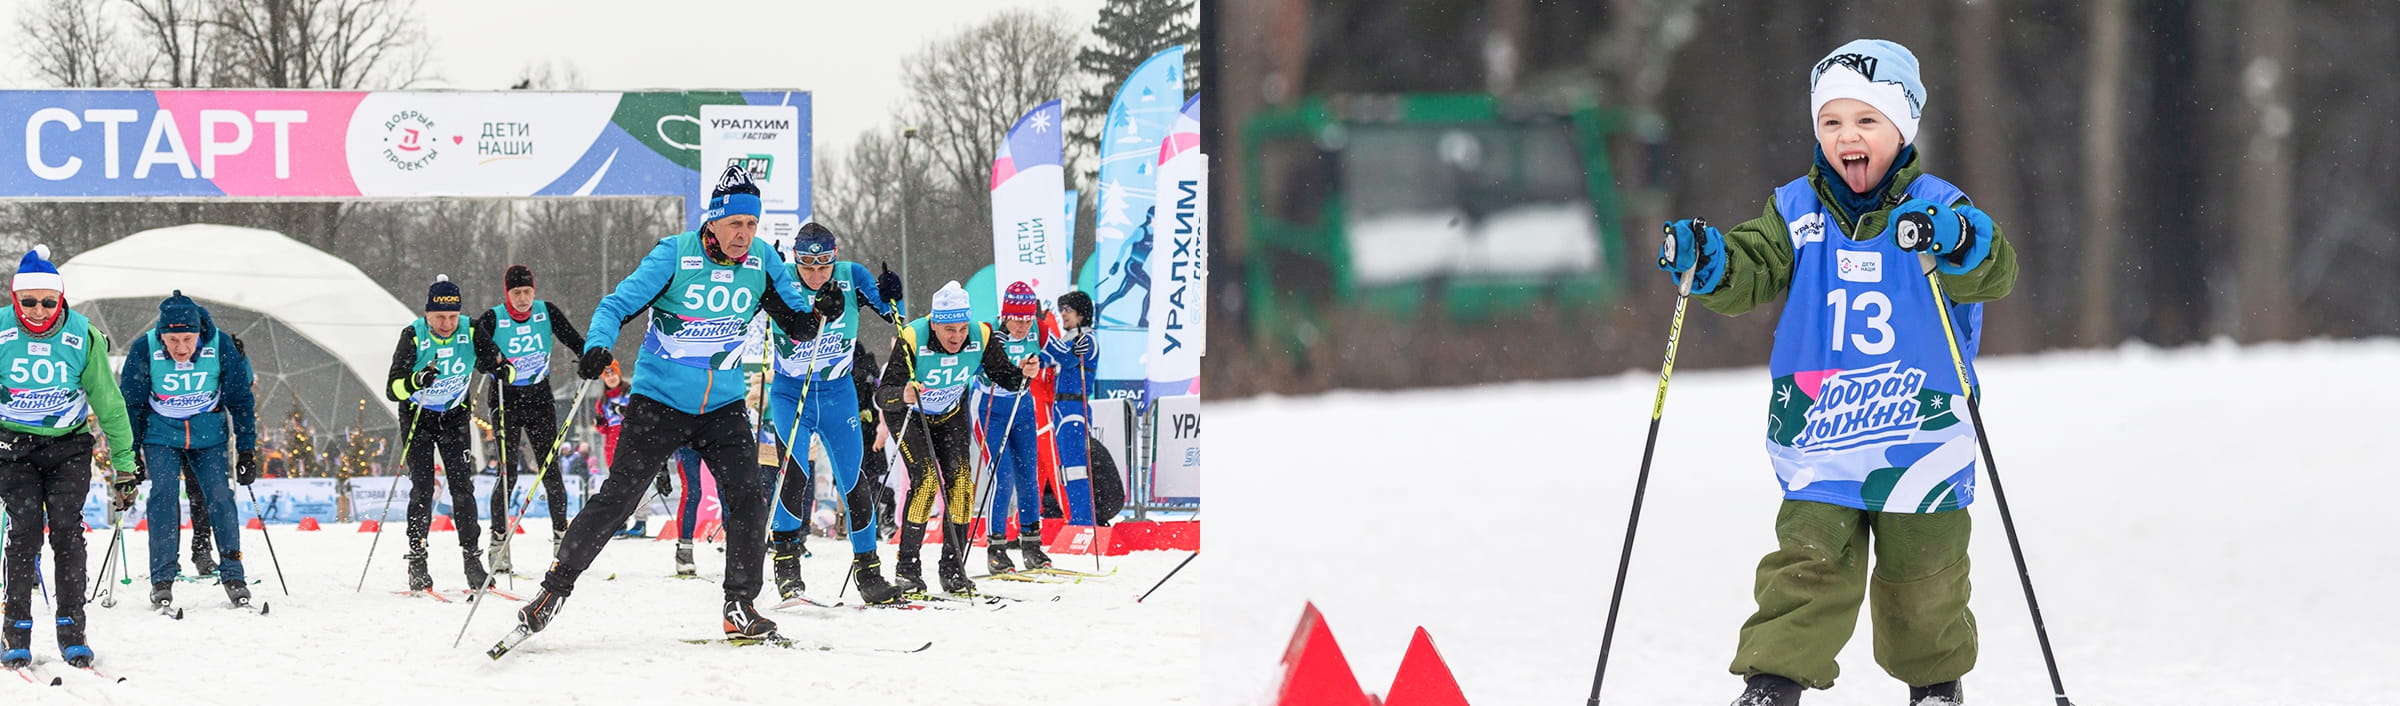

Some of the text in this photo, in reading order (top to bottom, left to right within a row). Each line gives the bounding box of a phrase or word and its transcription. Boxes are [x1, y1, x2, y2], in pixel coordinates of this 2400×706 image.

[385, 110, 435, 132] ДОБРЫЕ
[481, 122, 530, 139] ДЕТИ
[710, 119, 789, 130] УРАЛХИМ
[25, 107, 308, 181] СТАРТ
[478, 141, 533, 155] НАШИ
[383, 148, 438, 171] ПРОЕКТЫ
[1017, 222, 1033, 263] ДЕТИ
[1032, 217, 1046, 265] НАШИ
[1163, 180, 1197, 355] УРАЛХИМ
[682, 284, 752, 313] 500
[1827, 288, 1896, 355] 13
[508, 333, 544, 354] 521
[9, 358, 68, 384] 501
[162, 372, 208, 391] 517
[923, 366, 970, 386] 514
[1107, 390, 1145, 400] УРАЛ
